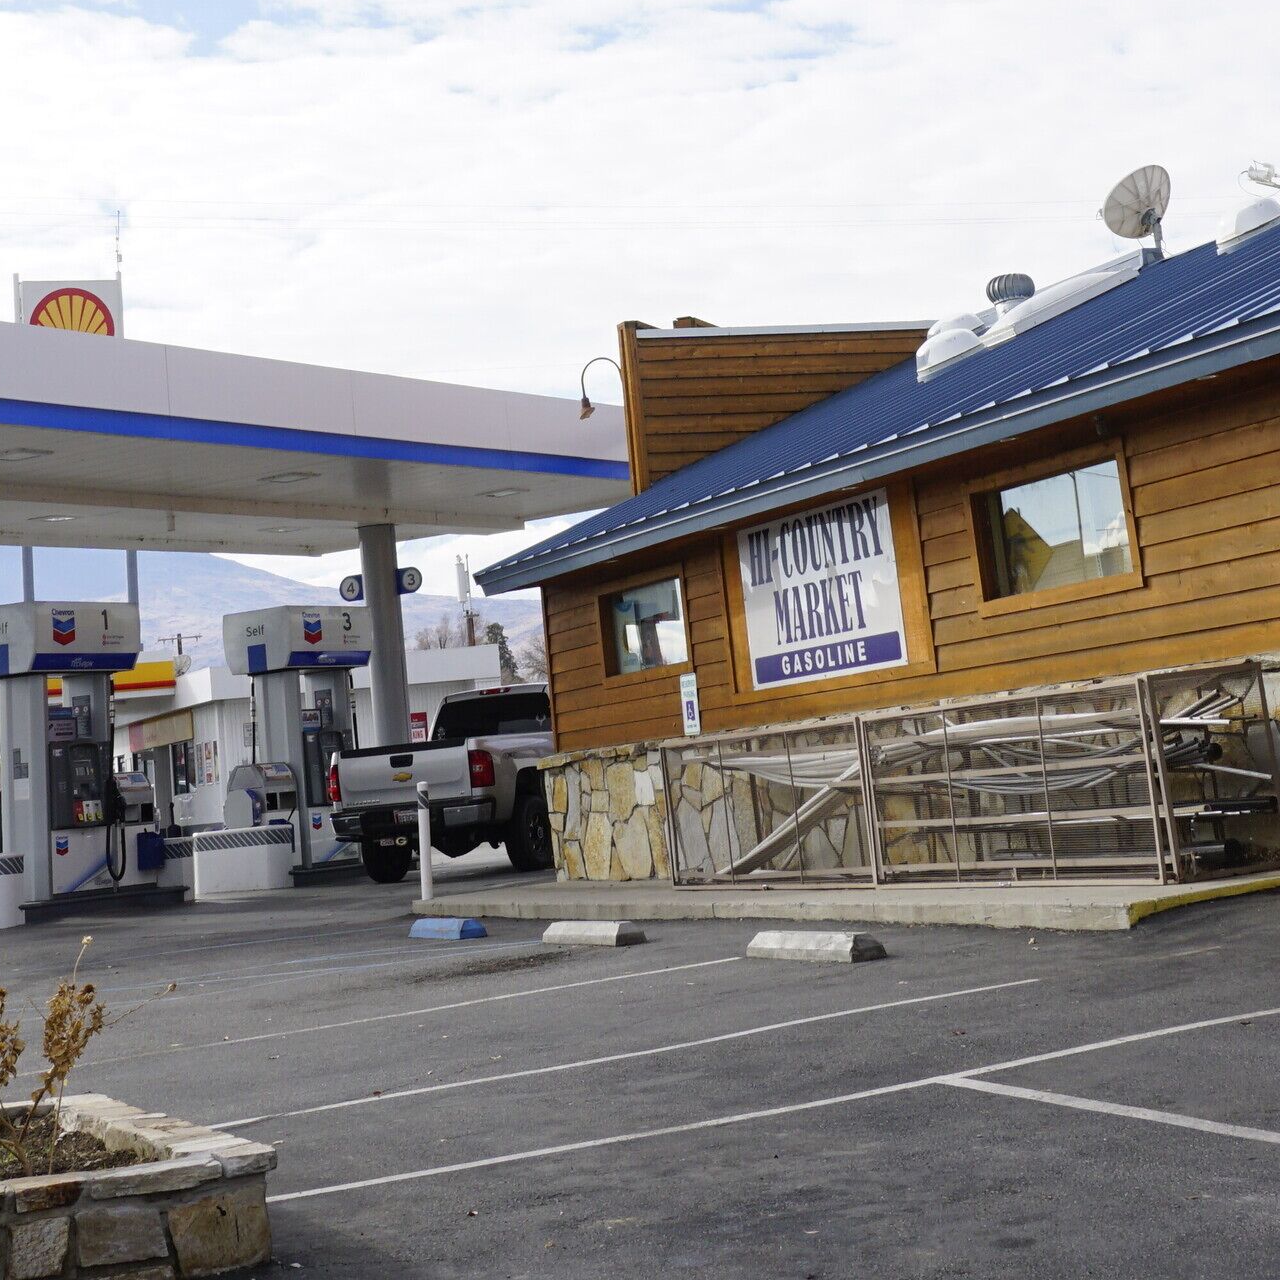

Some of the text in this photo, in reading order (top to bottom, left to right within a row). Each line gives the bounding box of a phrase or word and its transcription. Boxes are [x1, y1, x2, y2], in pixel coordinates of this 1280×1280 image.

[747, 496, 884, 587] HI-COUNTRY
[346, 582, 355, 595] 4
[406, 573, 416, 586] 3
[773, 570, 867, 646] MARKET
[51, 608, 109, 631] Chevron 1
[342, 612, 353, 631] 3
[245, 624, 265, 638] Self
[781, 640, 868, 676] GASOLINE
